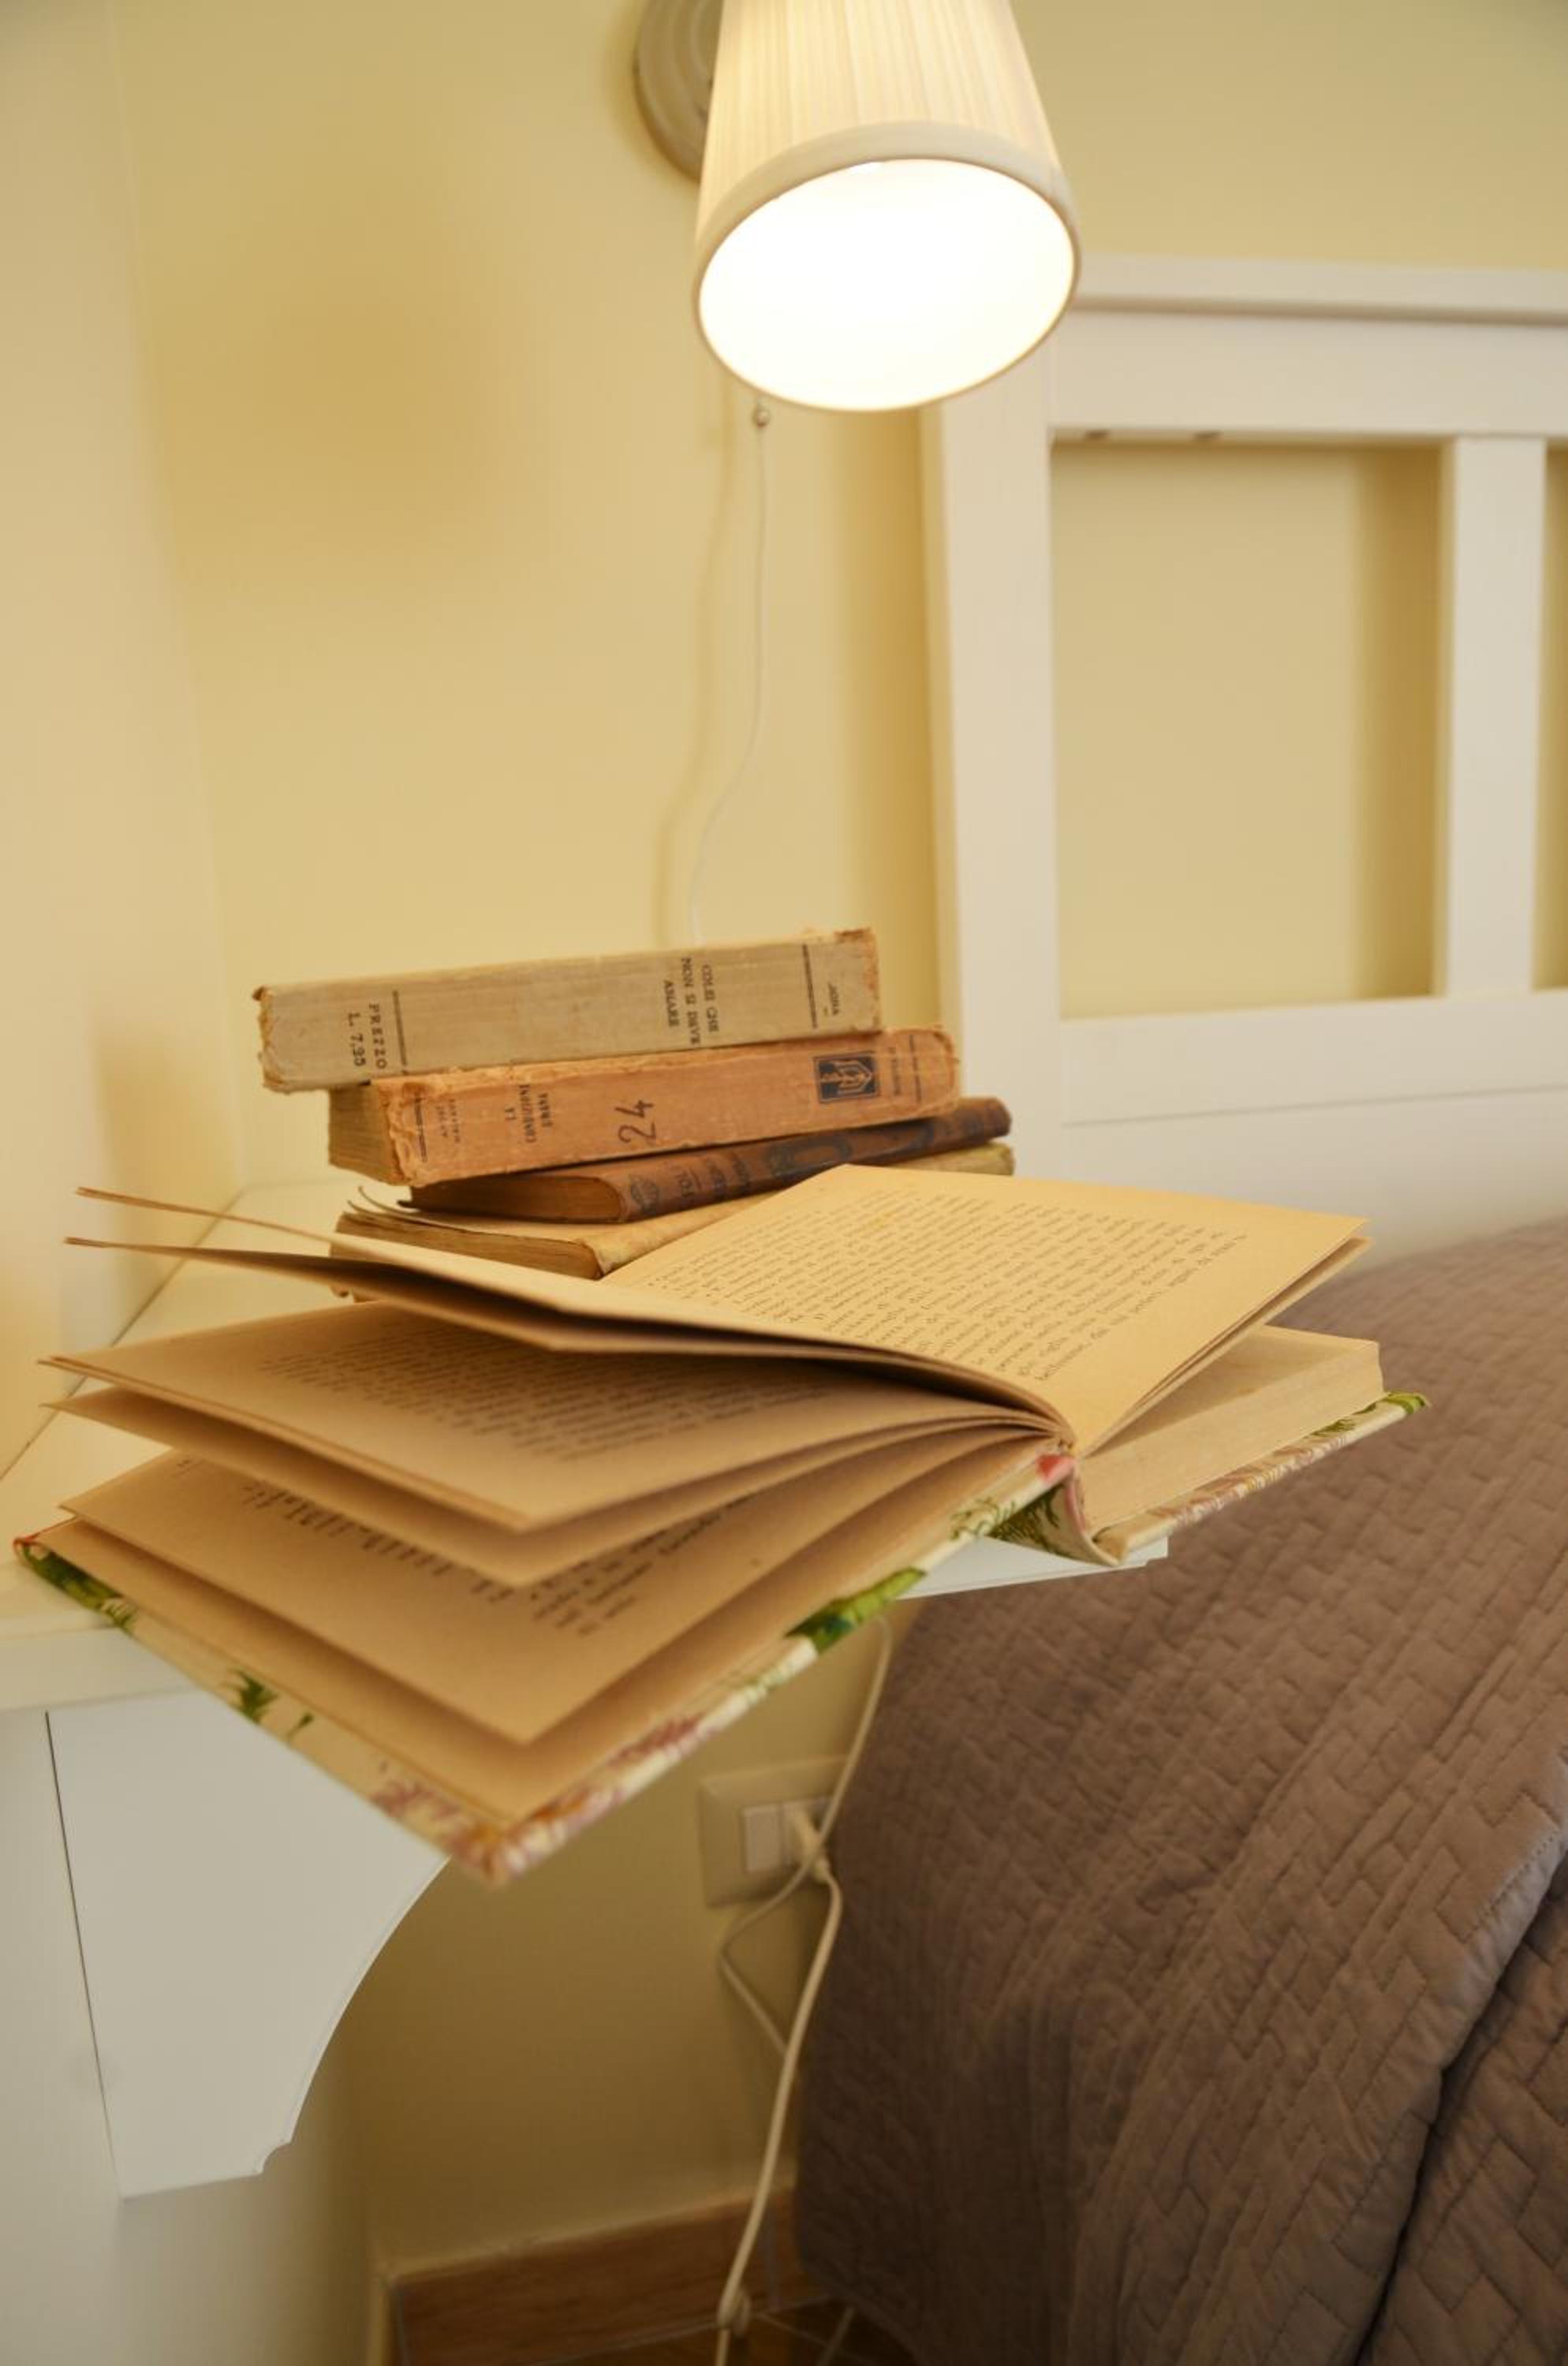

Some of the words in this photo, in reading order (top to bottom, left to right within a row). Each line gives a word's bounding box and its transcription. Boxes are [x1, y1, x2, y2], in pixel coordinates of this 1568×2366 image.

[681, 957, 694, 987] NON
[368, 1003, 387, 1070] PREZZO
[614, 1099, 655, 1144] 24
